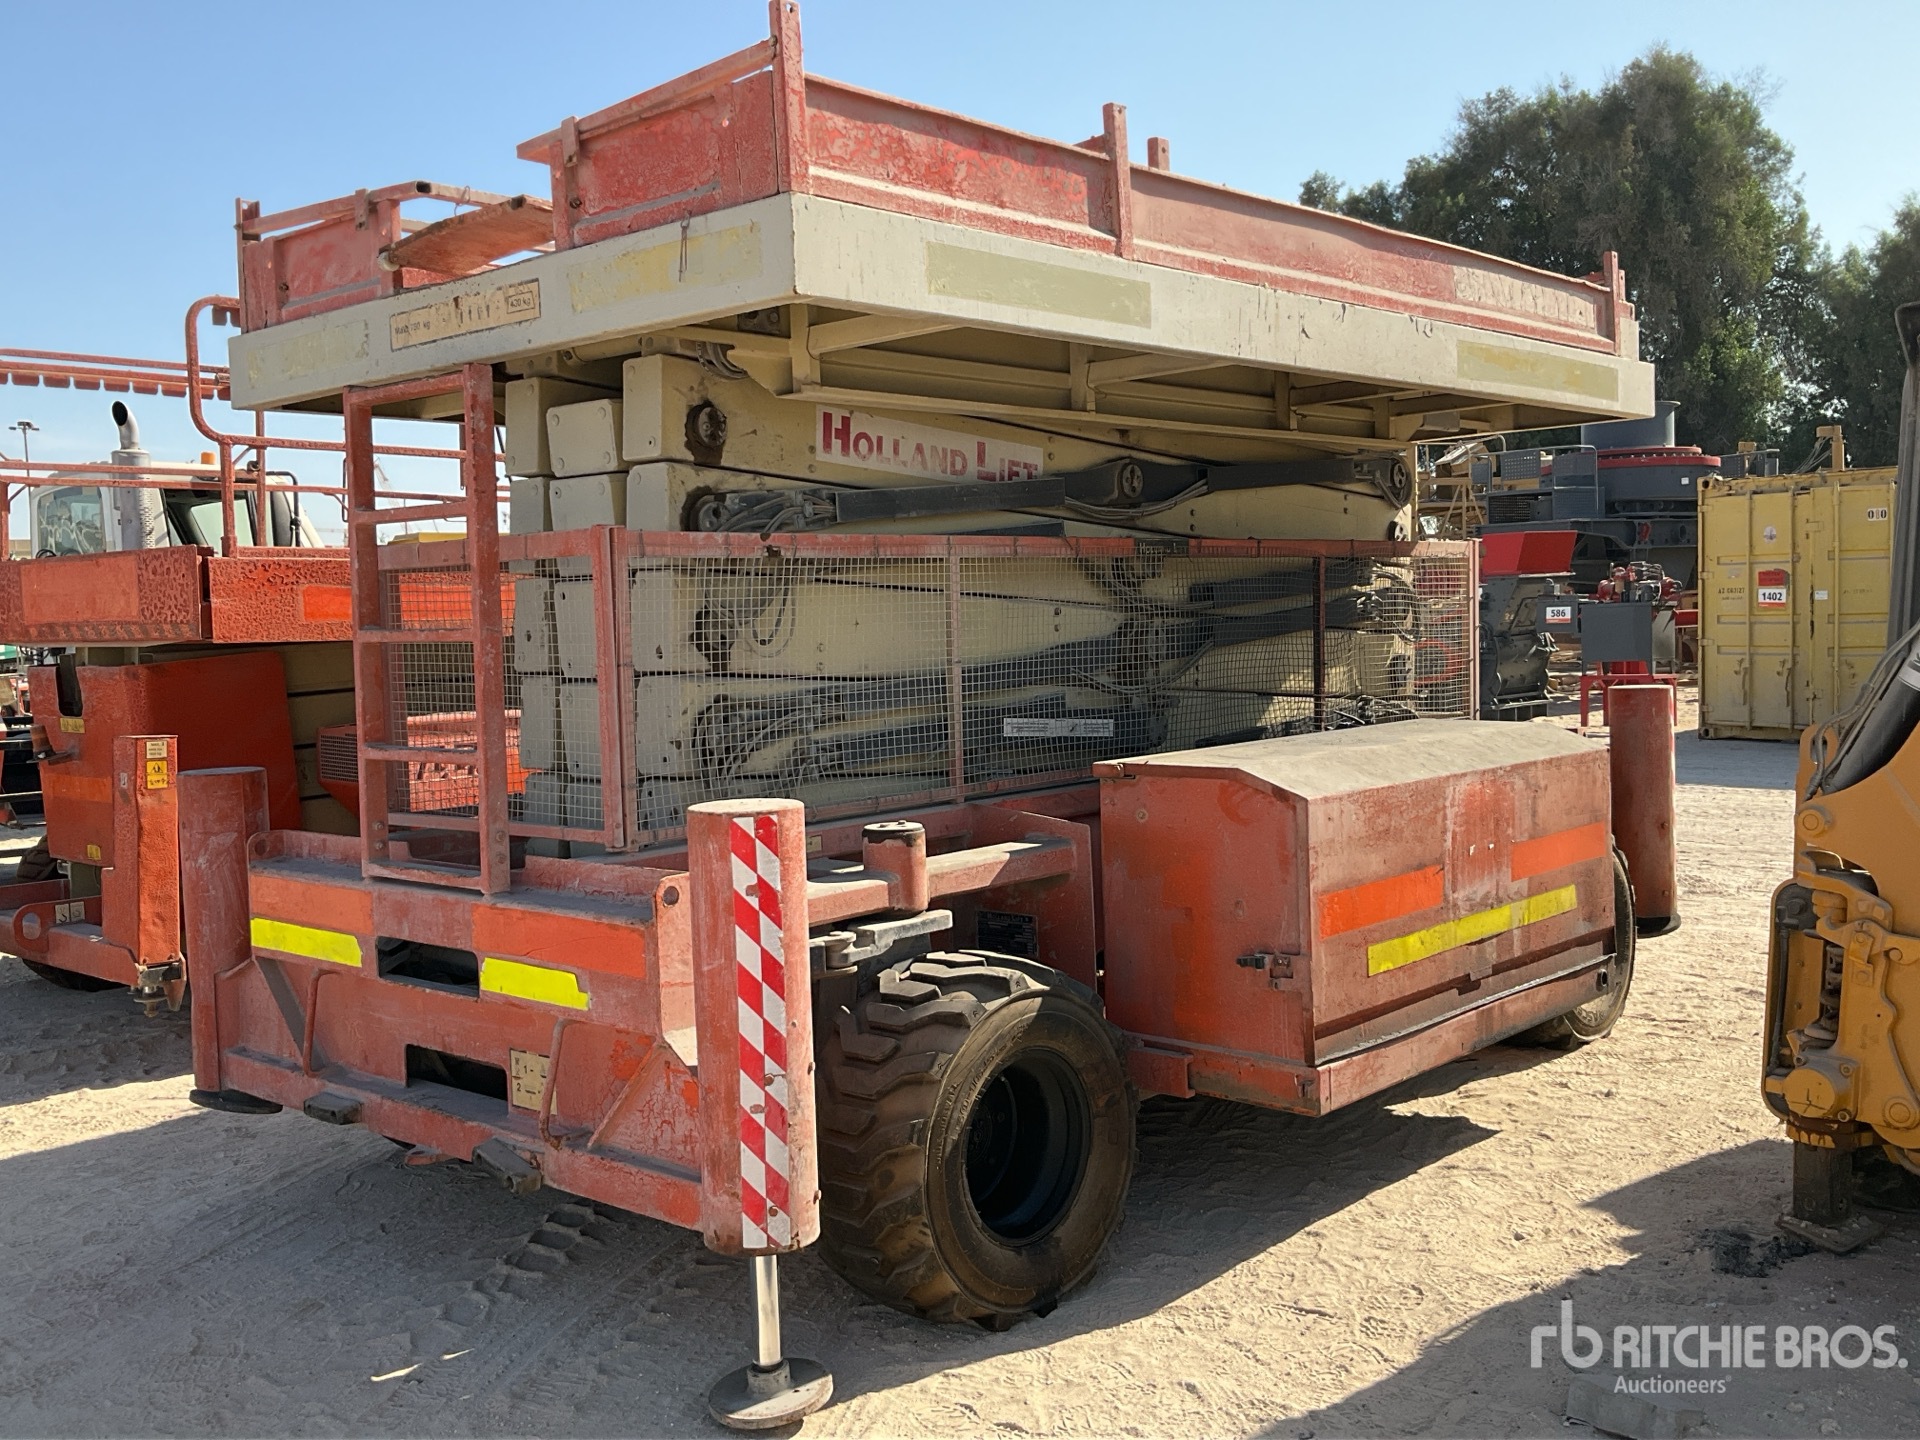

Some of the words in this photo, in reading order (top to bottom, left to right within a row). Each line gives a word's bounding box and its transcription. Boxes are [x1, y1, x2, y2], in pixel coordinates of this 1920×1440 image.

[822, 411, 968, 477] HOLLAND
[1762, 592, 1782, 601] 1402
[1551, 609, 1566, 617] 586
